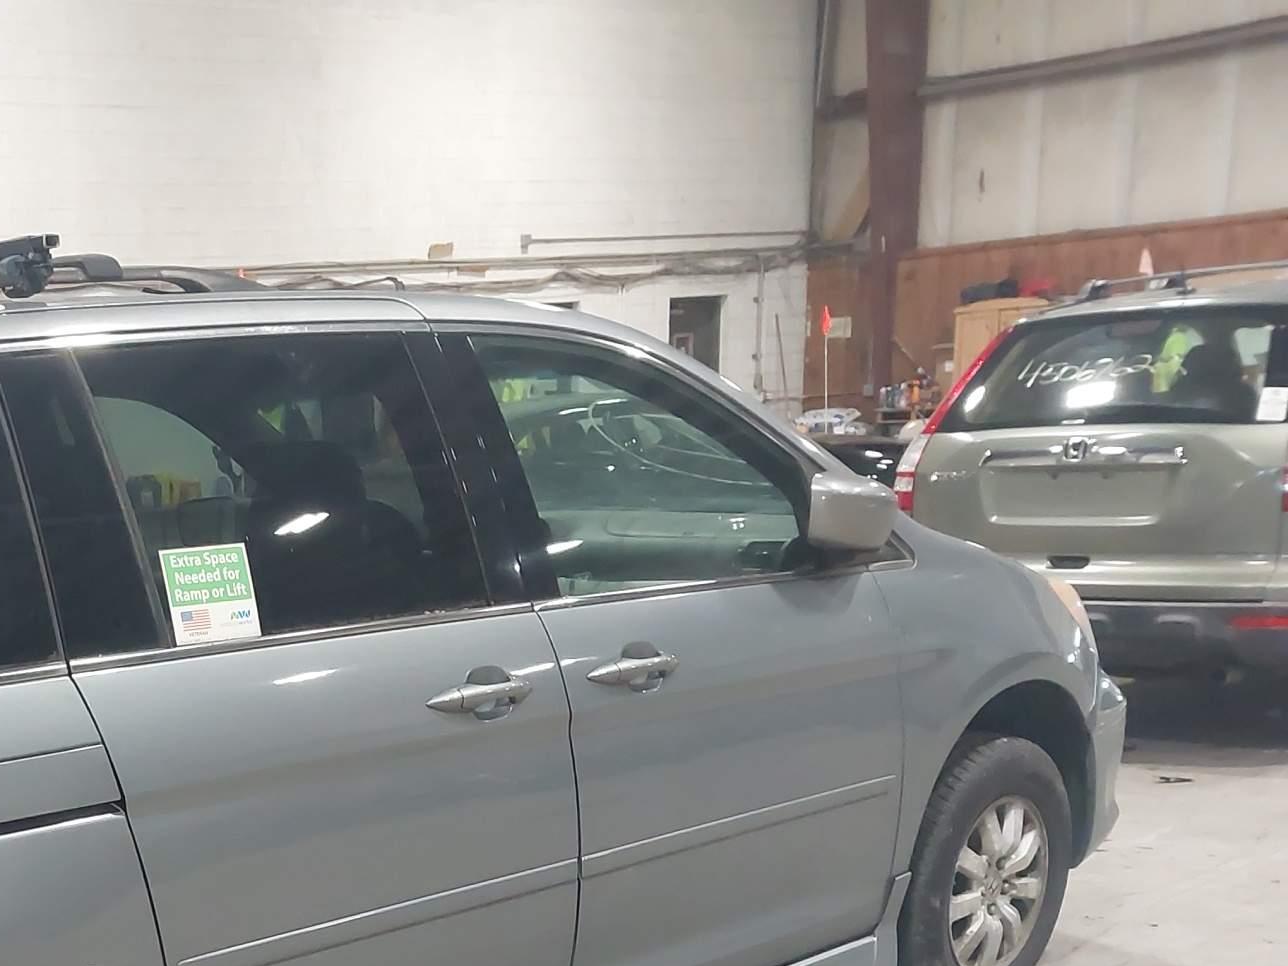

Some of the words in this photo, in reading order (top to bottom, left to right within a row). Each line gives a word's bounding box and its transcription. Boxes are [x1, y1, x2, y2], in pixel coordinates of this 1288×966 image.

[169, 554, 202, 568] Extra
[202, 551, 239, 567] Space
[174, 567, 221, 585] Needed
[222, 566, 240, 580] for
[174, 588, 210, 603] Ramp
[211, 587, 225, 598] or
[225, 582, 247, 596] Lift
